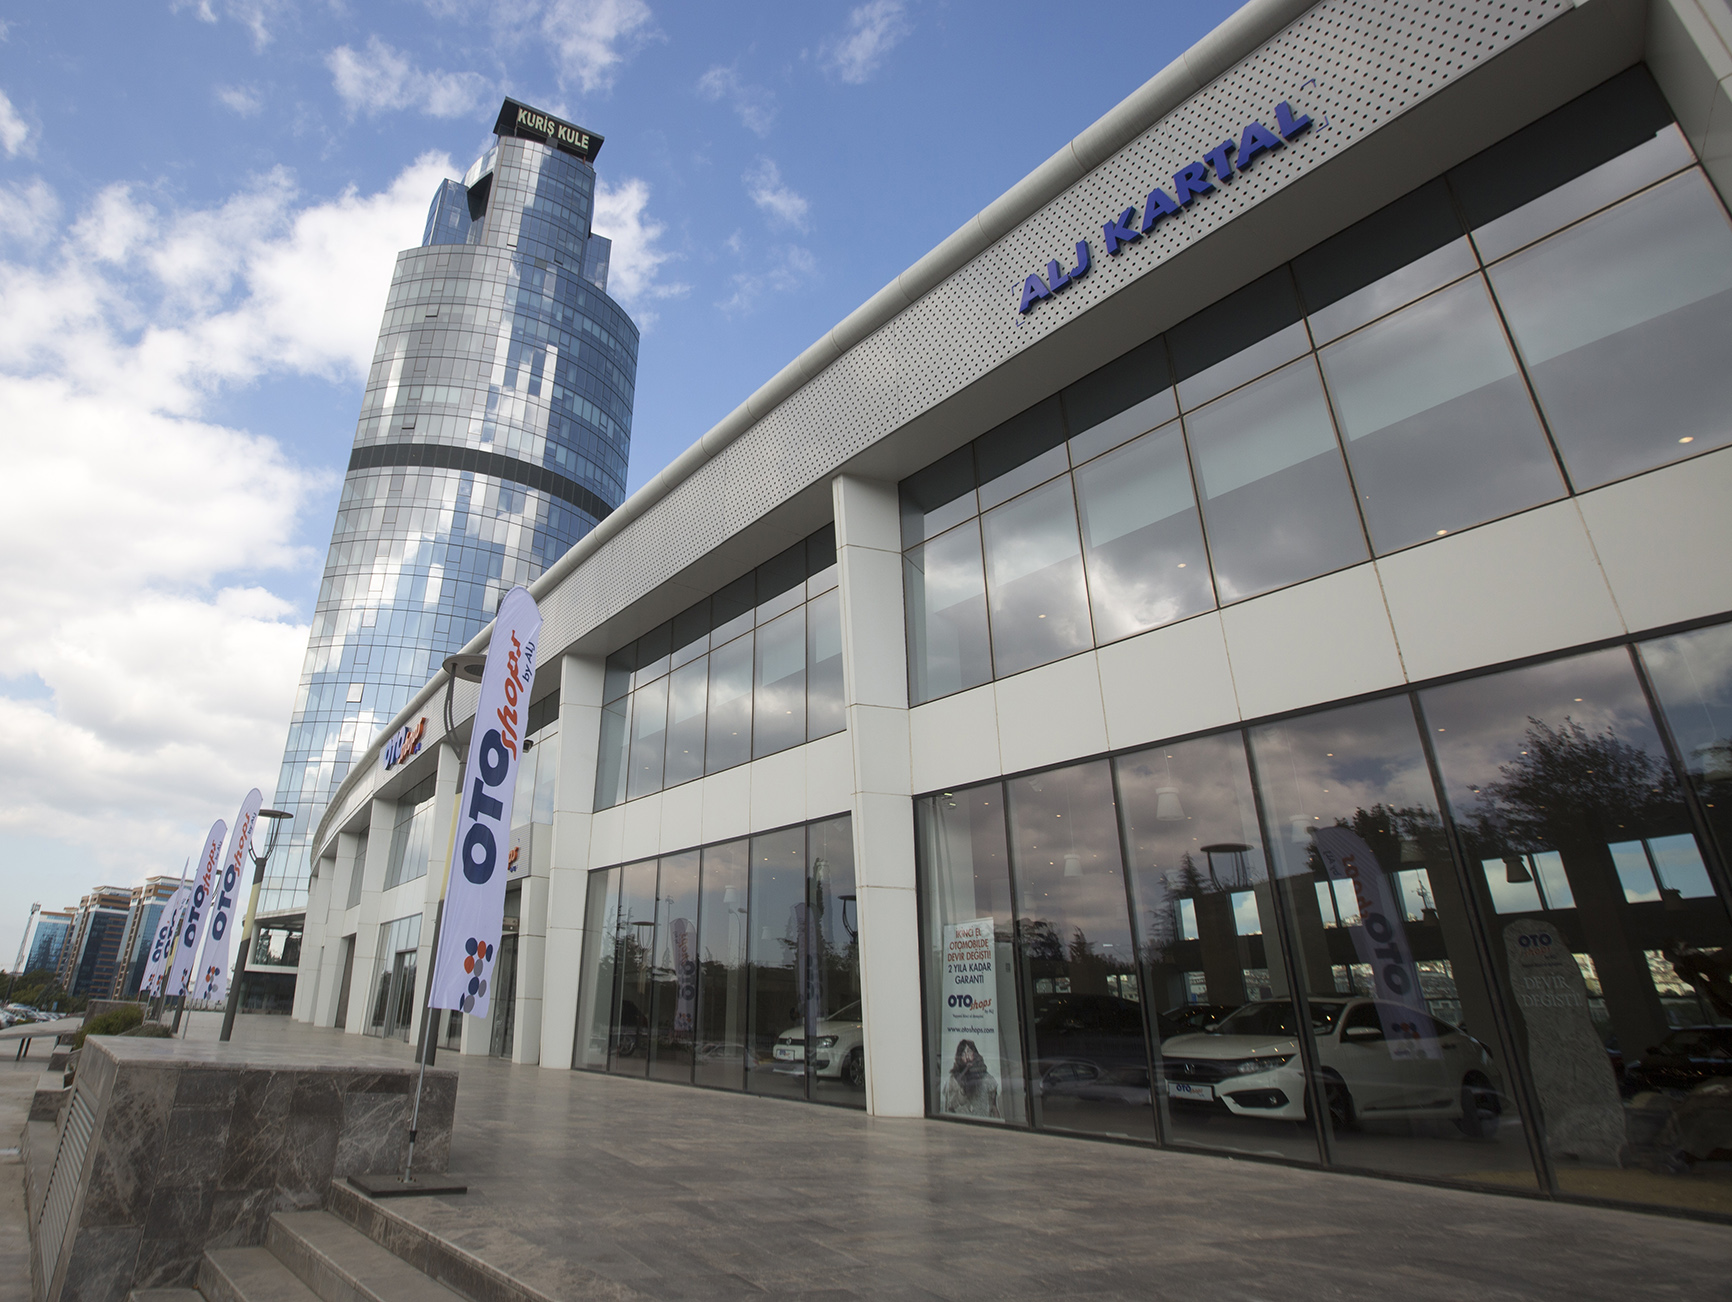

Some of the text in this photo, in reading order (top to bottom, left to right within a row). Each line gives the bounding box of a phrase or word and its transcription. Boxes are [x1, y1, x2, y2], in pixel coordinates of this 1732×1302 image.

[518, 108, 590, 149] KURİŞ KULE
[1019, 100, 1313, 316] ALJ KARTAL
[522, 664, 532, 683] by
[152, 926, 168, 963] OTO
[949, 937, 989, 951] OTOMOBİLDE
[1518, 933, 1552, 947] OTO
[947, 950, 965, 962] DEVİR
[948, 962, 991, 973] 2 YILA KADAR
[954, 971, 984, 985] GARANTİ
[947, 1025, 995, 1035] www.otoshops.com
